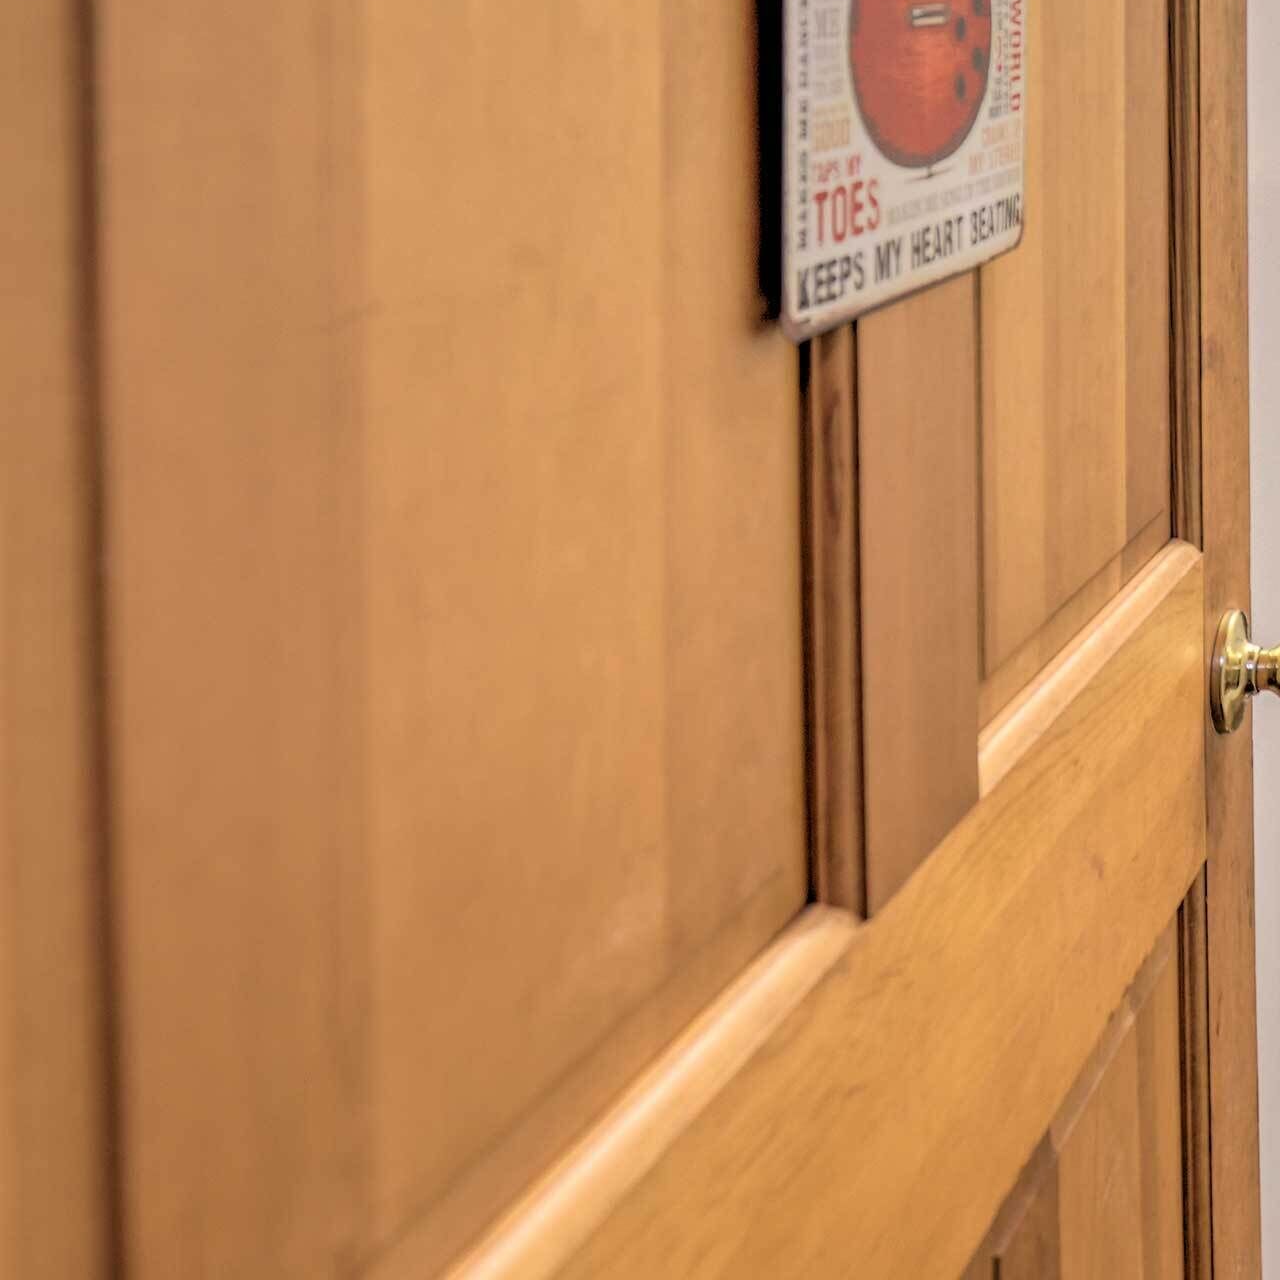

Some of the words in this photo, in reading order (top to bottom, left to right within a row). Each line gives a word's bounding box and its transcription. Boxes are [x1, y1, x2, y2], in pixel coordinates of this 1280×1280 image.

[1007, 0, 1023, 113] WORLD
[846, 153, 862, 176] MY
[797, 252, 865, 311] KEEPS
[874, 233, 904, 284] MY
[910, 214, 964, 270] HEART
[970, 192, 1021, 247] BEATING
[813, 178, 881, 246] TOES
